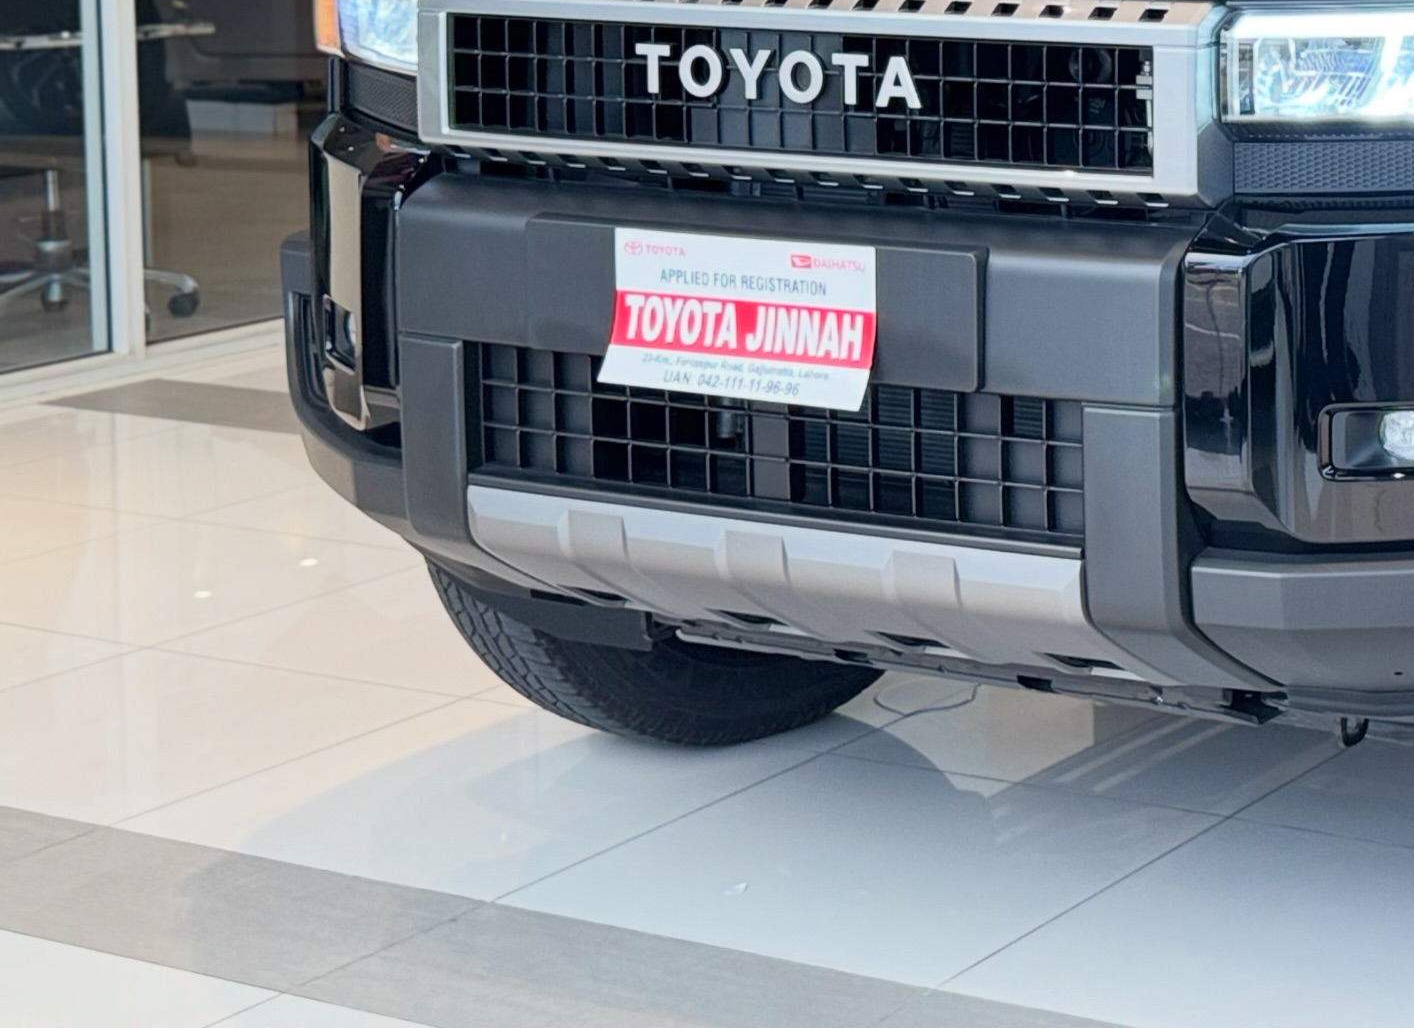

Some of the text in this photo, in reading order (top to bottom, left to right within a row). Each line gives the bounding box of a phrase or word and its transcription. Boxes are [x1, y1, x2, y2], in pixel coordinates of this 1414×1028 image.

[635, 42, 922, 109] TOYOTA
[645, 243, 686, 256] TOYOTA
[813, 257, 866, 272] DAIHATSU
[660, 268, 827, 296] APPLIED FOR REGISTRATION
[625, 293, 864, 361] TOYOTA JINNAH
[663, 369, 800, 397] UAN 042-111-11-96-96
